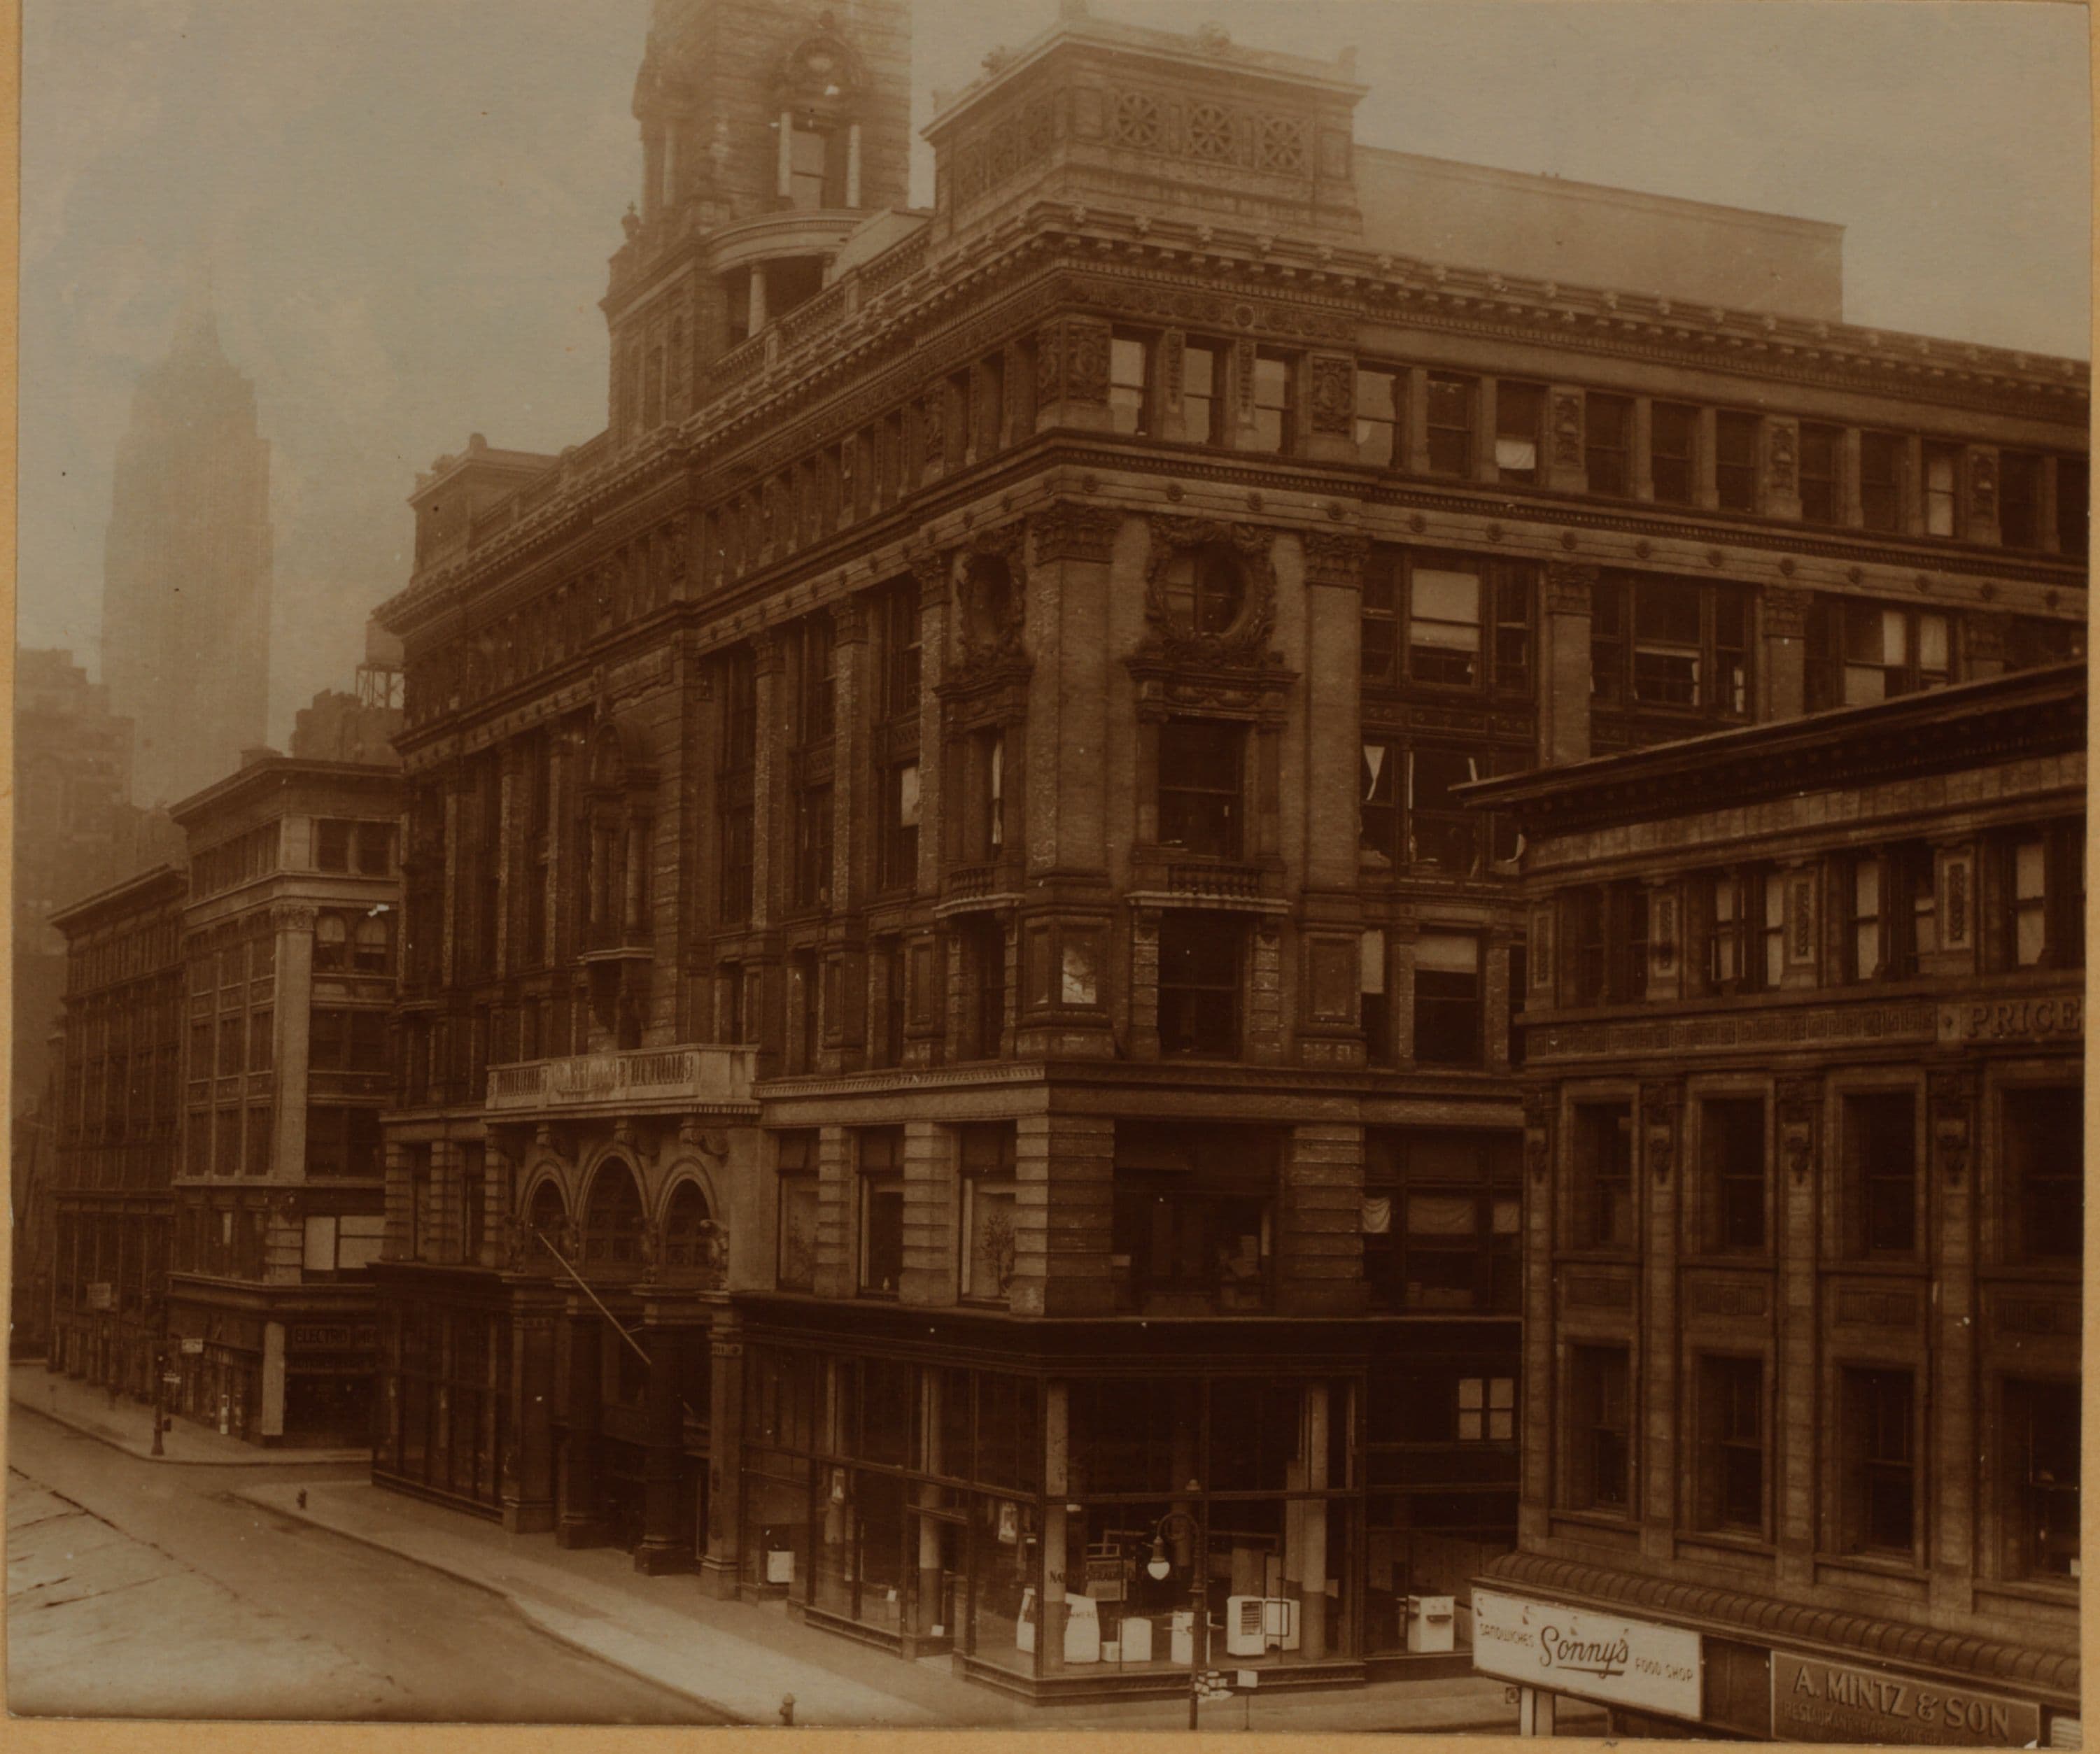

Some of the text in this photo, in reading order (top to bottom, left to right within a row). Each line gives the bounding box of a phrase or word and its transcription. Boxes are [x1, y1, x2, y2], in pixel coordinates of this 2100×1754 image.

[1539, 1625, 1629, 1679] Sonny's
[1635, 1657, 1693, 1682] FOOD SHOP
[1793, 1665, 1821, 1697] A.
[1824, 1671, 1910, 1719] MINTZ
[1916, 1692, 1938, 1721] &
[1943, 1696, 2010, 1740] SON
